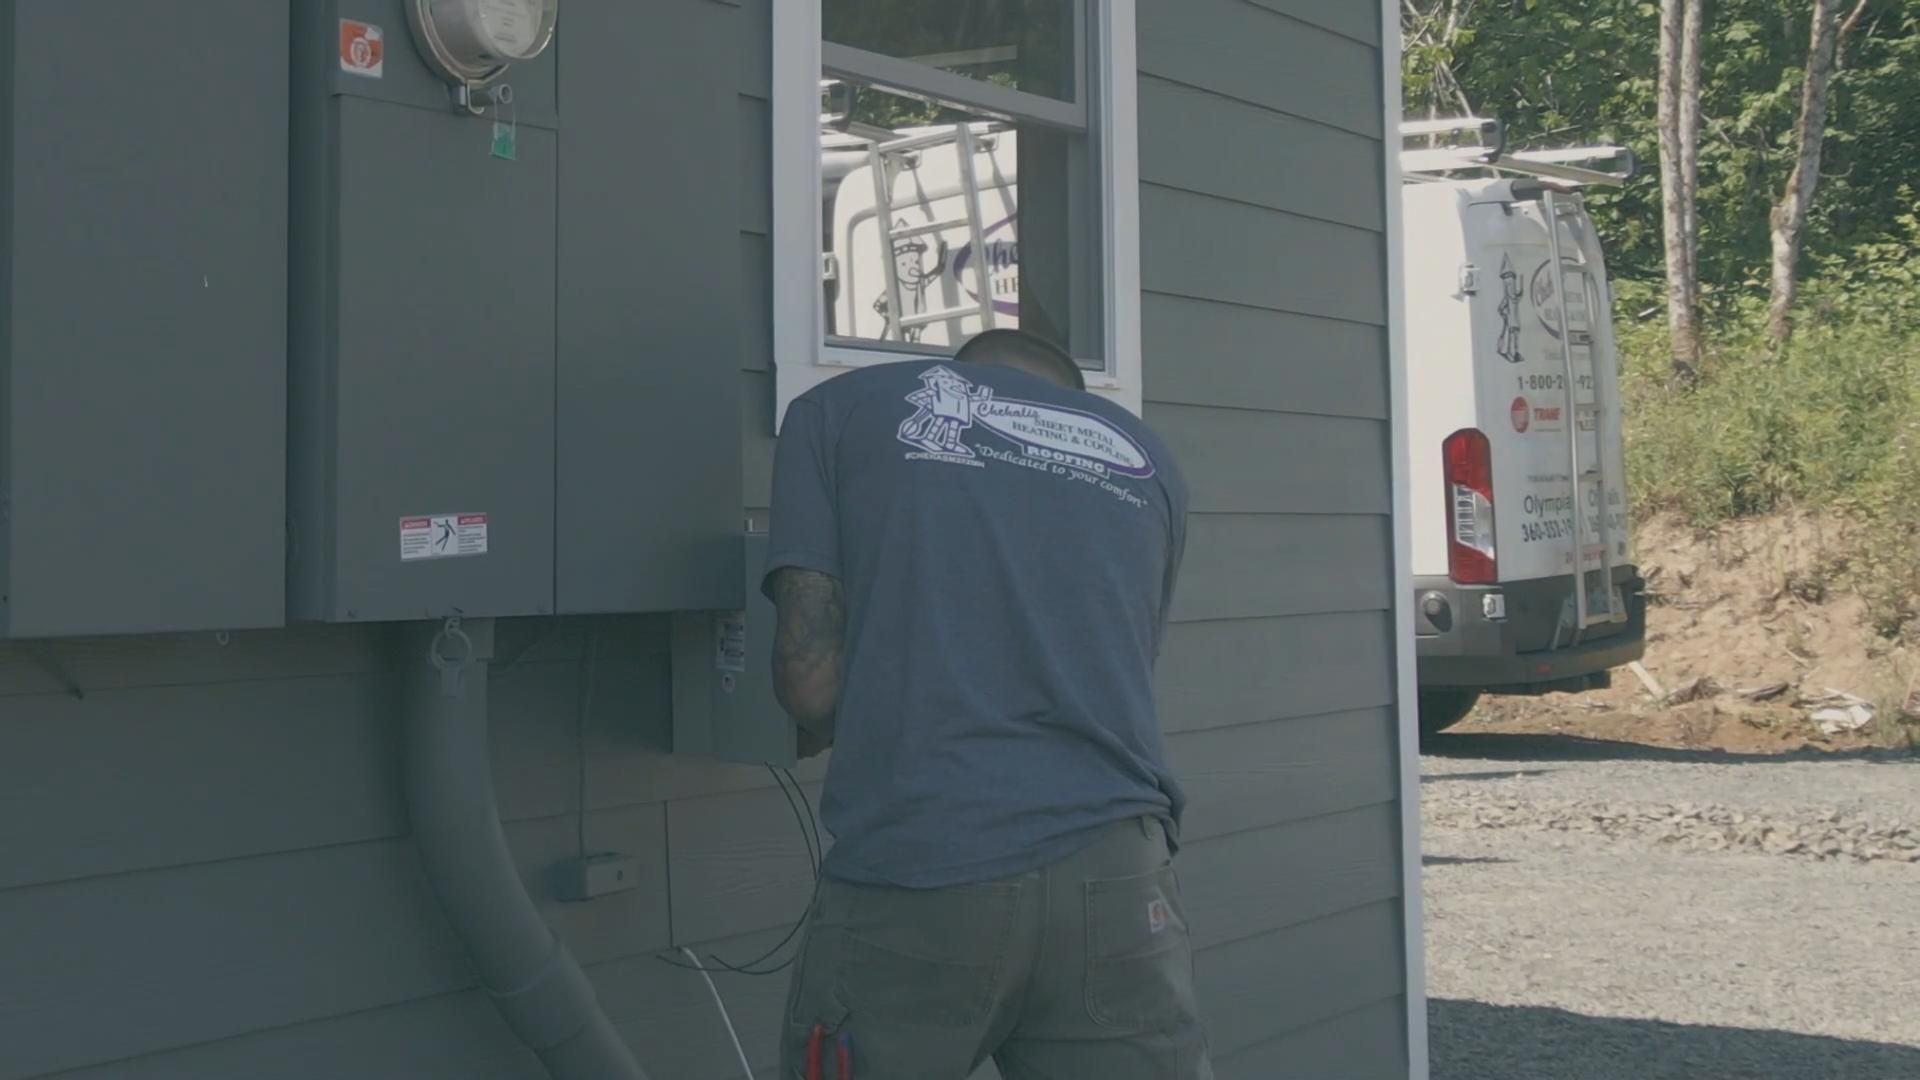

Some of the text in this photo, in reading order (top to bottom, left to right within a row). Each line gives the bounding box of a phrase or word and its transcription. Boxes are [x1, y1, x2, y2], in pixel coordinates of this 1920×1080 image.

[977, 402, 1040, 419] Chehalis
[1534, 407, 1561, 421] TRANE
[1012, 421, 1068, 442] HEATING
[1071, 435, 1081, 446] &
[1034, 416, 1114, 447] SHEET METAL
[1026, 445, 1105, 473] ROOFING
[1052, 464, 1066, 475] to
[1067, 470, 1099, 485] your
